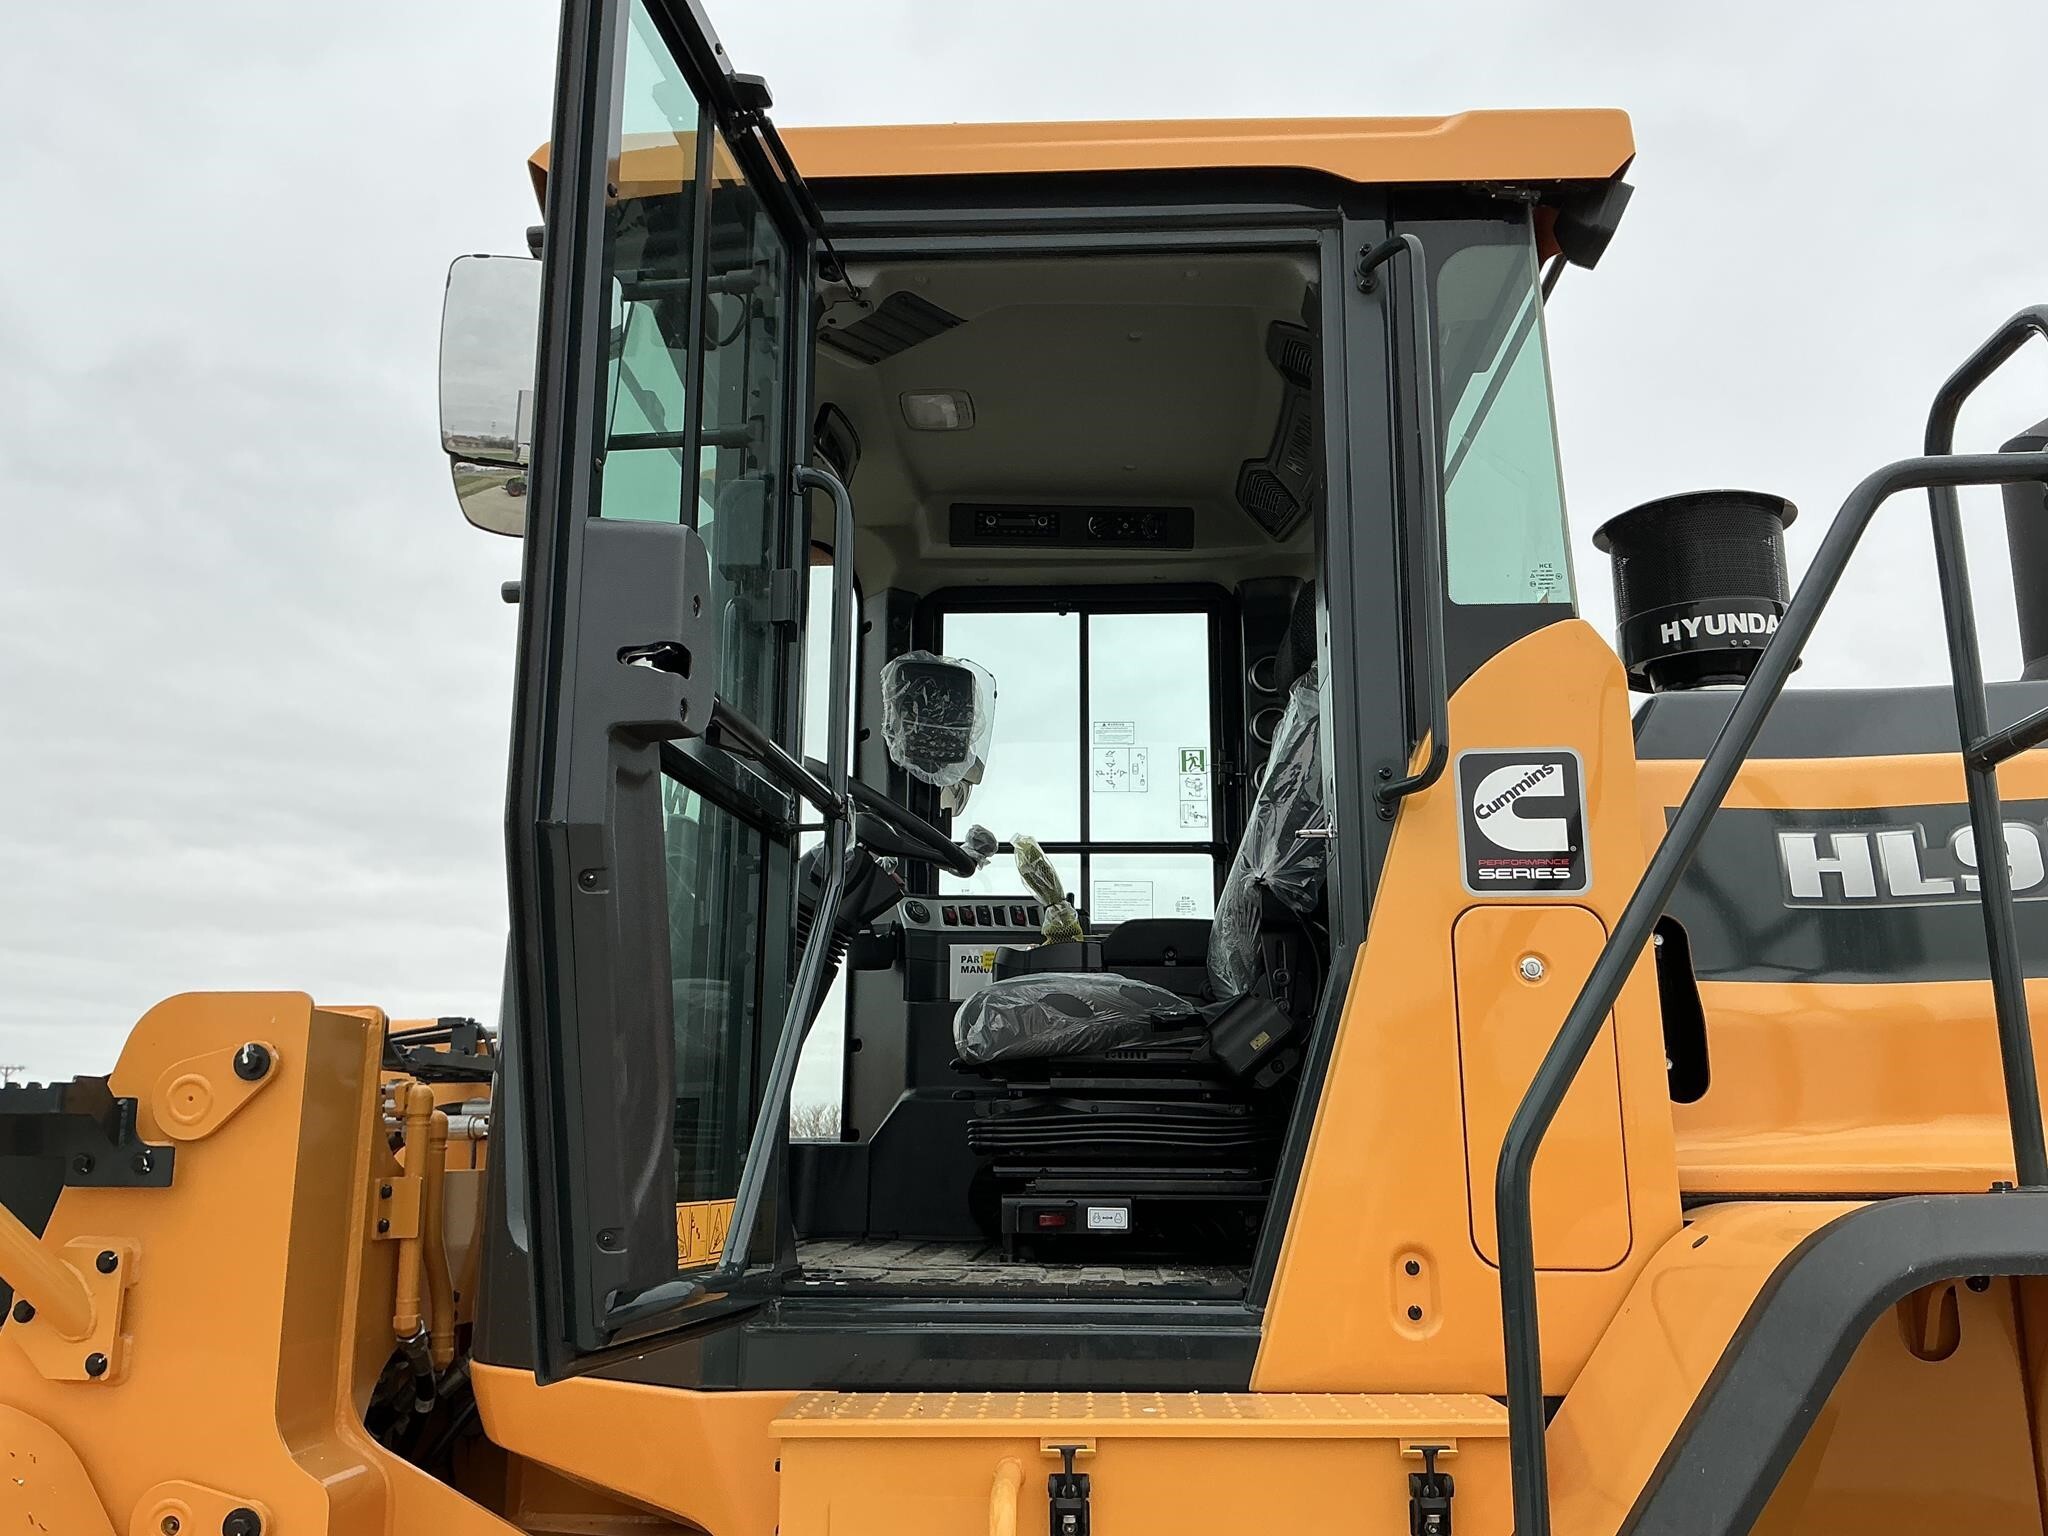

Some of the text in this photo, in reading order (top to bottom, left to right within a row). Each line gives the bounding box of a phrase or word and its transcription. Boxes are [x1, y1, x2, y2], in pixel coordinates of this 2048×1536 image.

[1660, 613, 1783, 645] HYUNDA
[1475, 763, 1555, 820] Cummins
[1478, 858, 1570, 866] PERFORMANCE
[1779, 822, 2048, 898] HL9
[1478, 867, 1571, 880] SERIES
[960, 965, 992, 974] MANU
